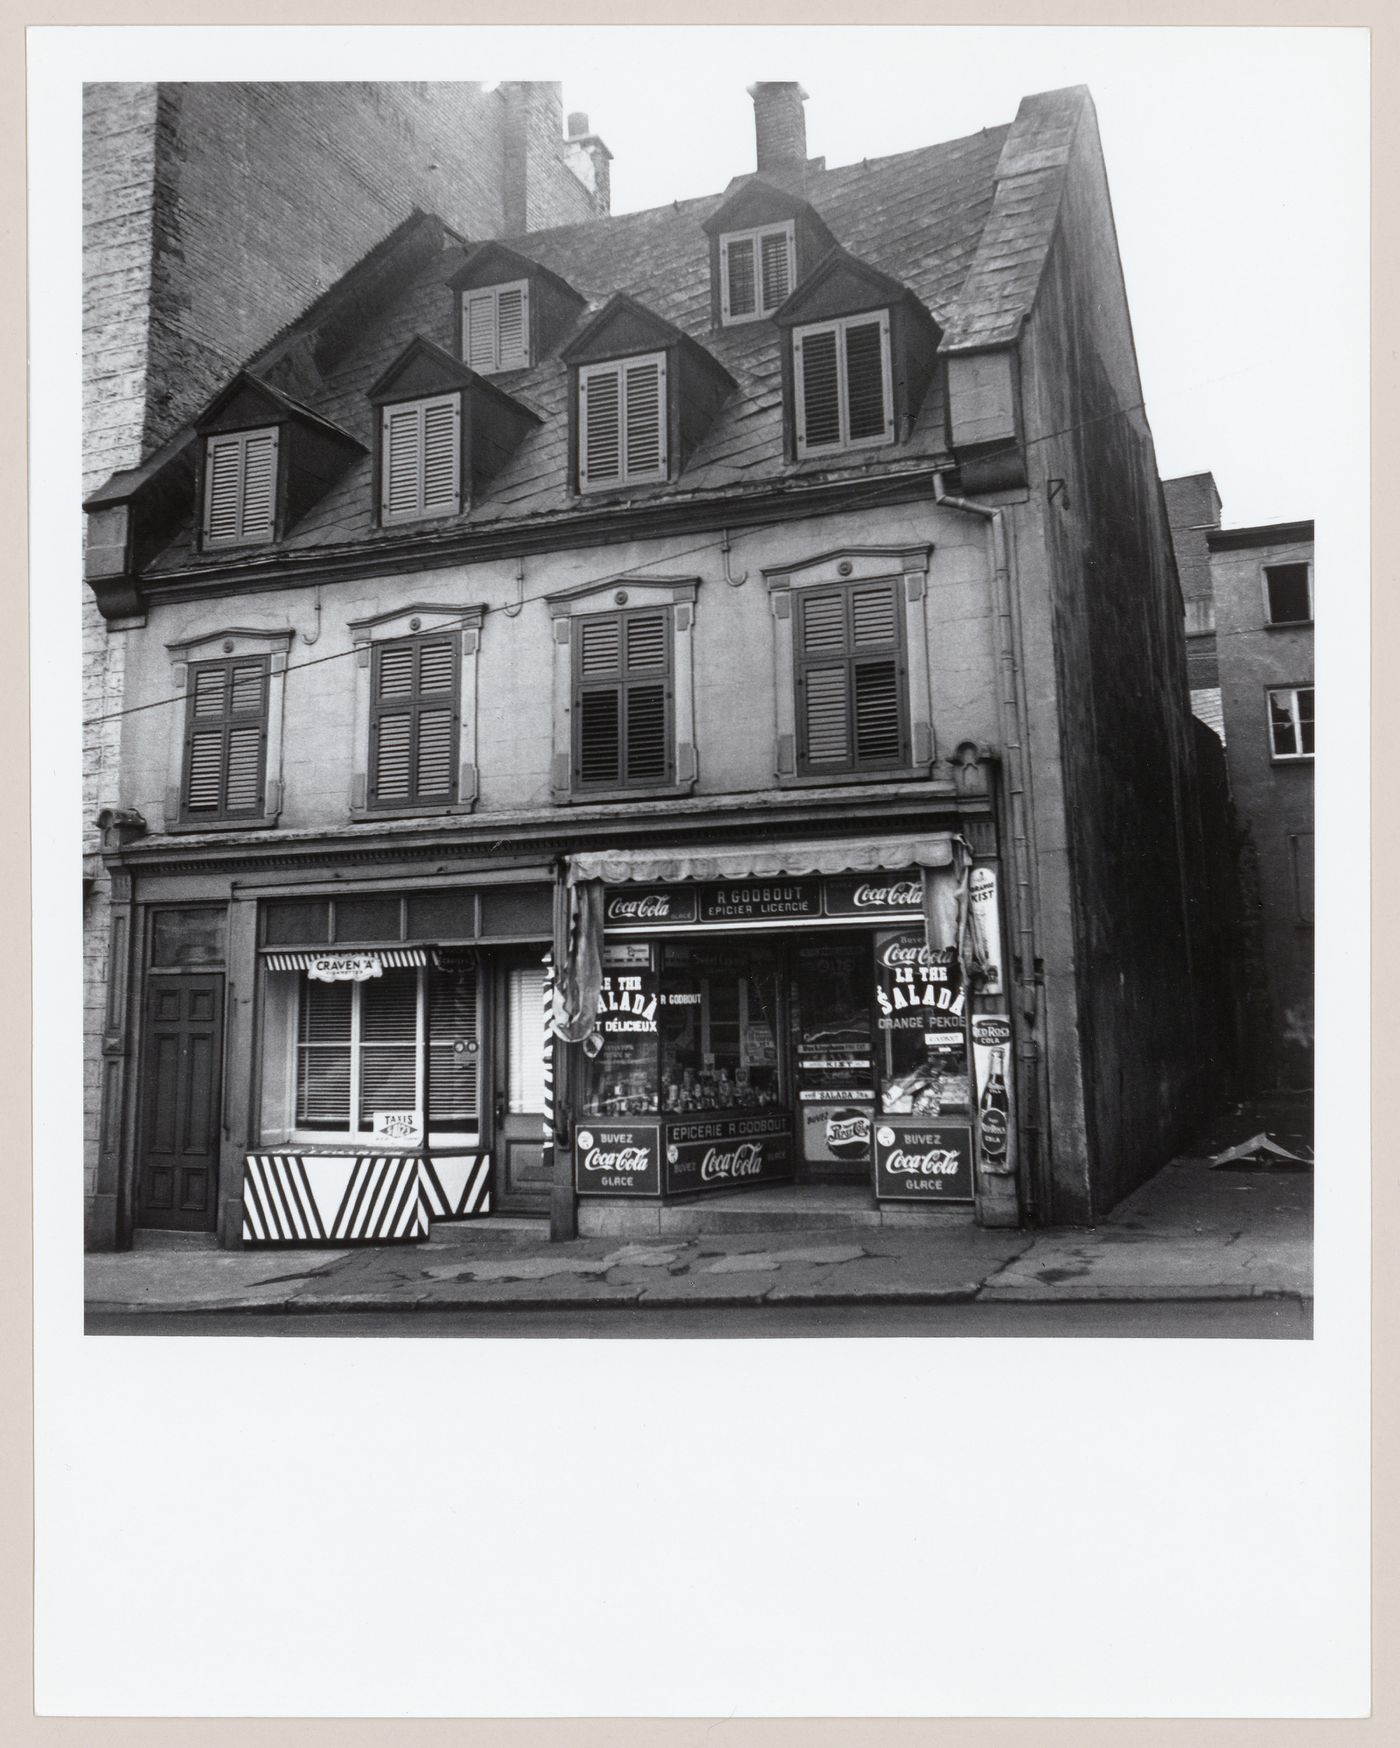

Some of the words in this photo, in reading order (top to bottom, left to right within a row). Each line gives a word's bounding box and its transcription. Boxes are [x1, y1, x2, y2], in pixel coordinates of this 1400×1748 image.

[717, 891, 726, 904] R
[731, 887, 803, 903] GODBOUT
[853, 881, 923, 906] Coca-Cola
[971, 890, 994, 903] KIST
[608, 895, 671, 919] Coca-Cola
[316, 960, 361, 971] CRAVEN
[896, 968, 914, 982] LE
[919, 967, 948, 982] THE
[600, 977, 611, 990] E
[618, 976, 642, 990] THE
[596, 991, 657, 1021] ALADA
[660, 995, 666, 1004] R
[669, 994, 701, 1004] GODBOUT
[877, 984, 966, 1017] SALADA
[605, 1018, 657, 1032] DÉLICIEUX
[878, 1017, 923, 1029] ORANGE
[929, 1016, 966, 1028] PEKOE
[826, 1060, 853, 1068] KIST
[820, 1091, 853, 1099] SALADA
[384, 1115, 413, 1125] TAXIS
[729, 1123, 736, 1135] R
[739, 1119, 787, 1134] GODBOUT
[601, 1134, 633, 1144] BUVEZ
[904, 1134, 942, 1145] BUVEZ
[584, 1147, 650, 1171] Coca-Cola
[701, 1142, 763, 1181] Coca-Cola
[886, 1149, 961, 1175] Coca-Cola
